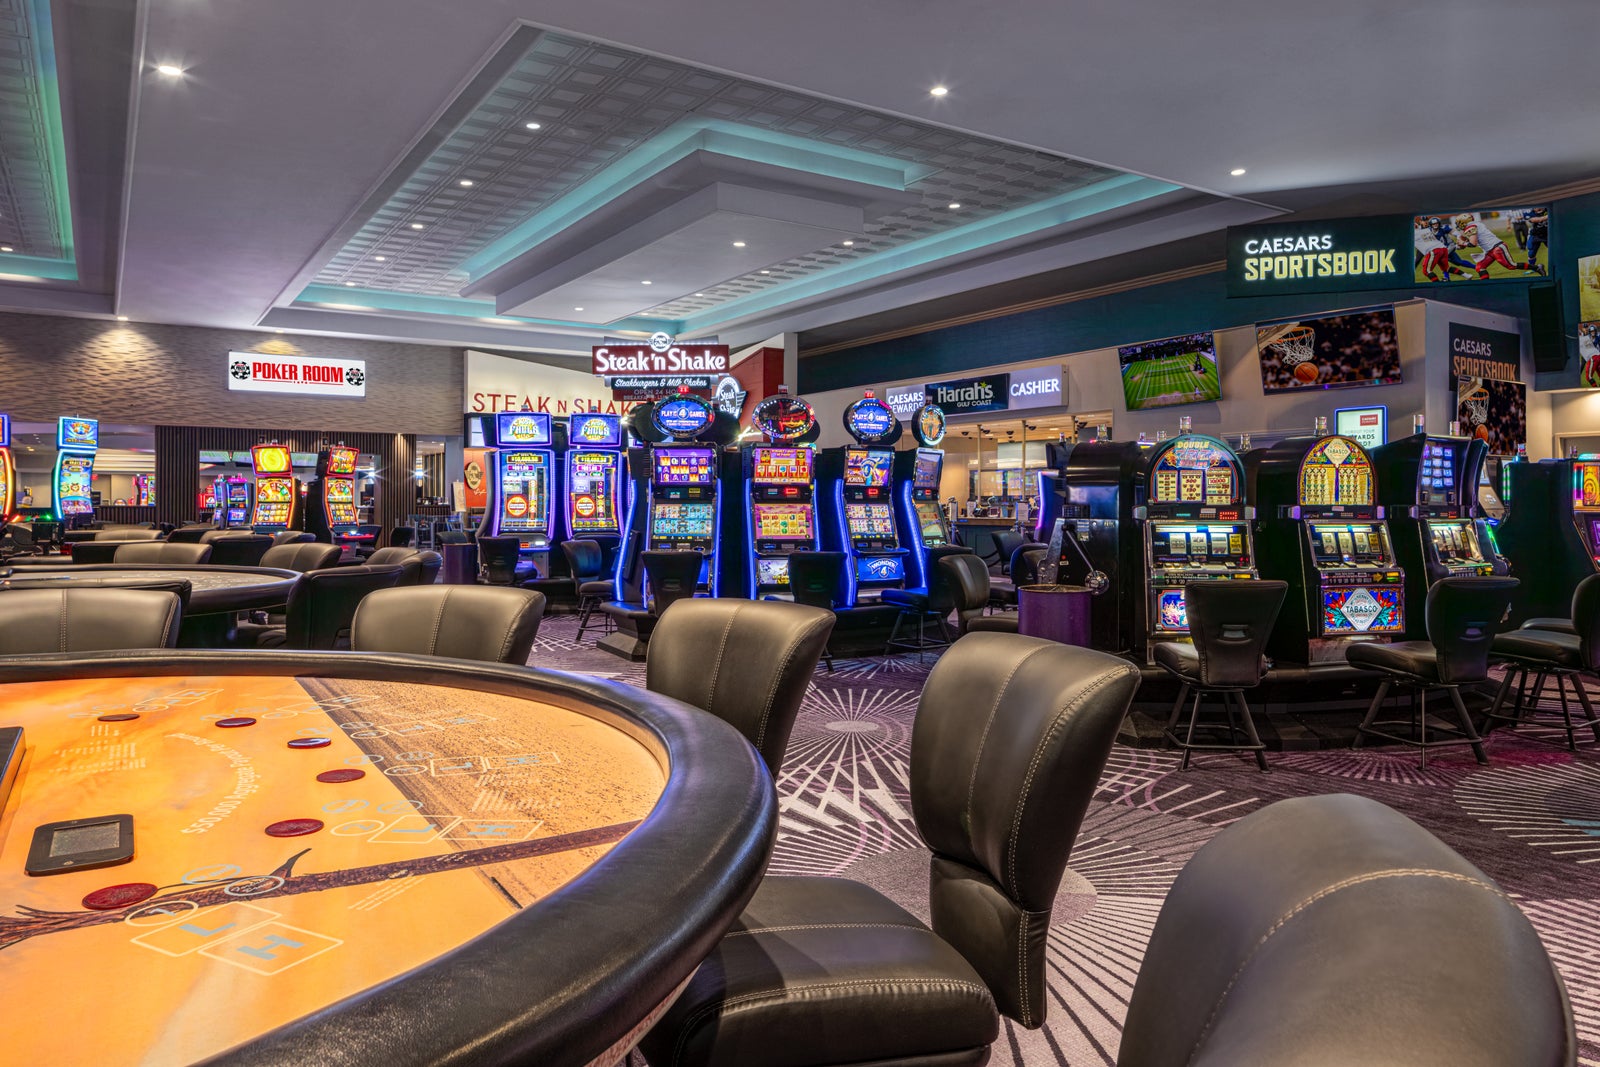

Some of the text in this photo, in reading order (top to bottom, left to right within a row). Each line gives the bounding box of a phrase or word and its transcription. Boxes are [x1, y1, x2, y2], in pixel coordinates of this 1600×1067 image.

[1244, 234, 1332, 254] CAESARS
[1244, 248, 1396, 281] SPORTSBOOK
[1453, 338, 1492, 356] CAESARS
[667, 348, 726, 371] Shake
[1453, 355, 1517, 381] SPORTSBOOK
[252, 362, 344, 383] POKER ROOM
[614, 378, 659, 389] Steakburgers
[1010, 378, 1060, 397] CASHIER
[472, 392, 646, 415] STEAK N SHAK
[888, 391, 924, 405] CAESARS
[678, 409, 686, 417] 4
[1177, 441, 1210, 449] DOUBLE
[1345, 605, 1378, 613] TABASCO
[180, 800, 242, 834] $50,000
[390, 823, 438, 833] L
[467, 823, 517, 836] H
[178, 921, 238, 937] L
[235, 934, 305, 961] H
